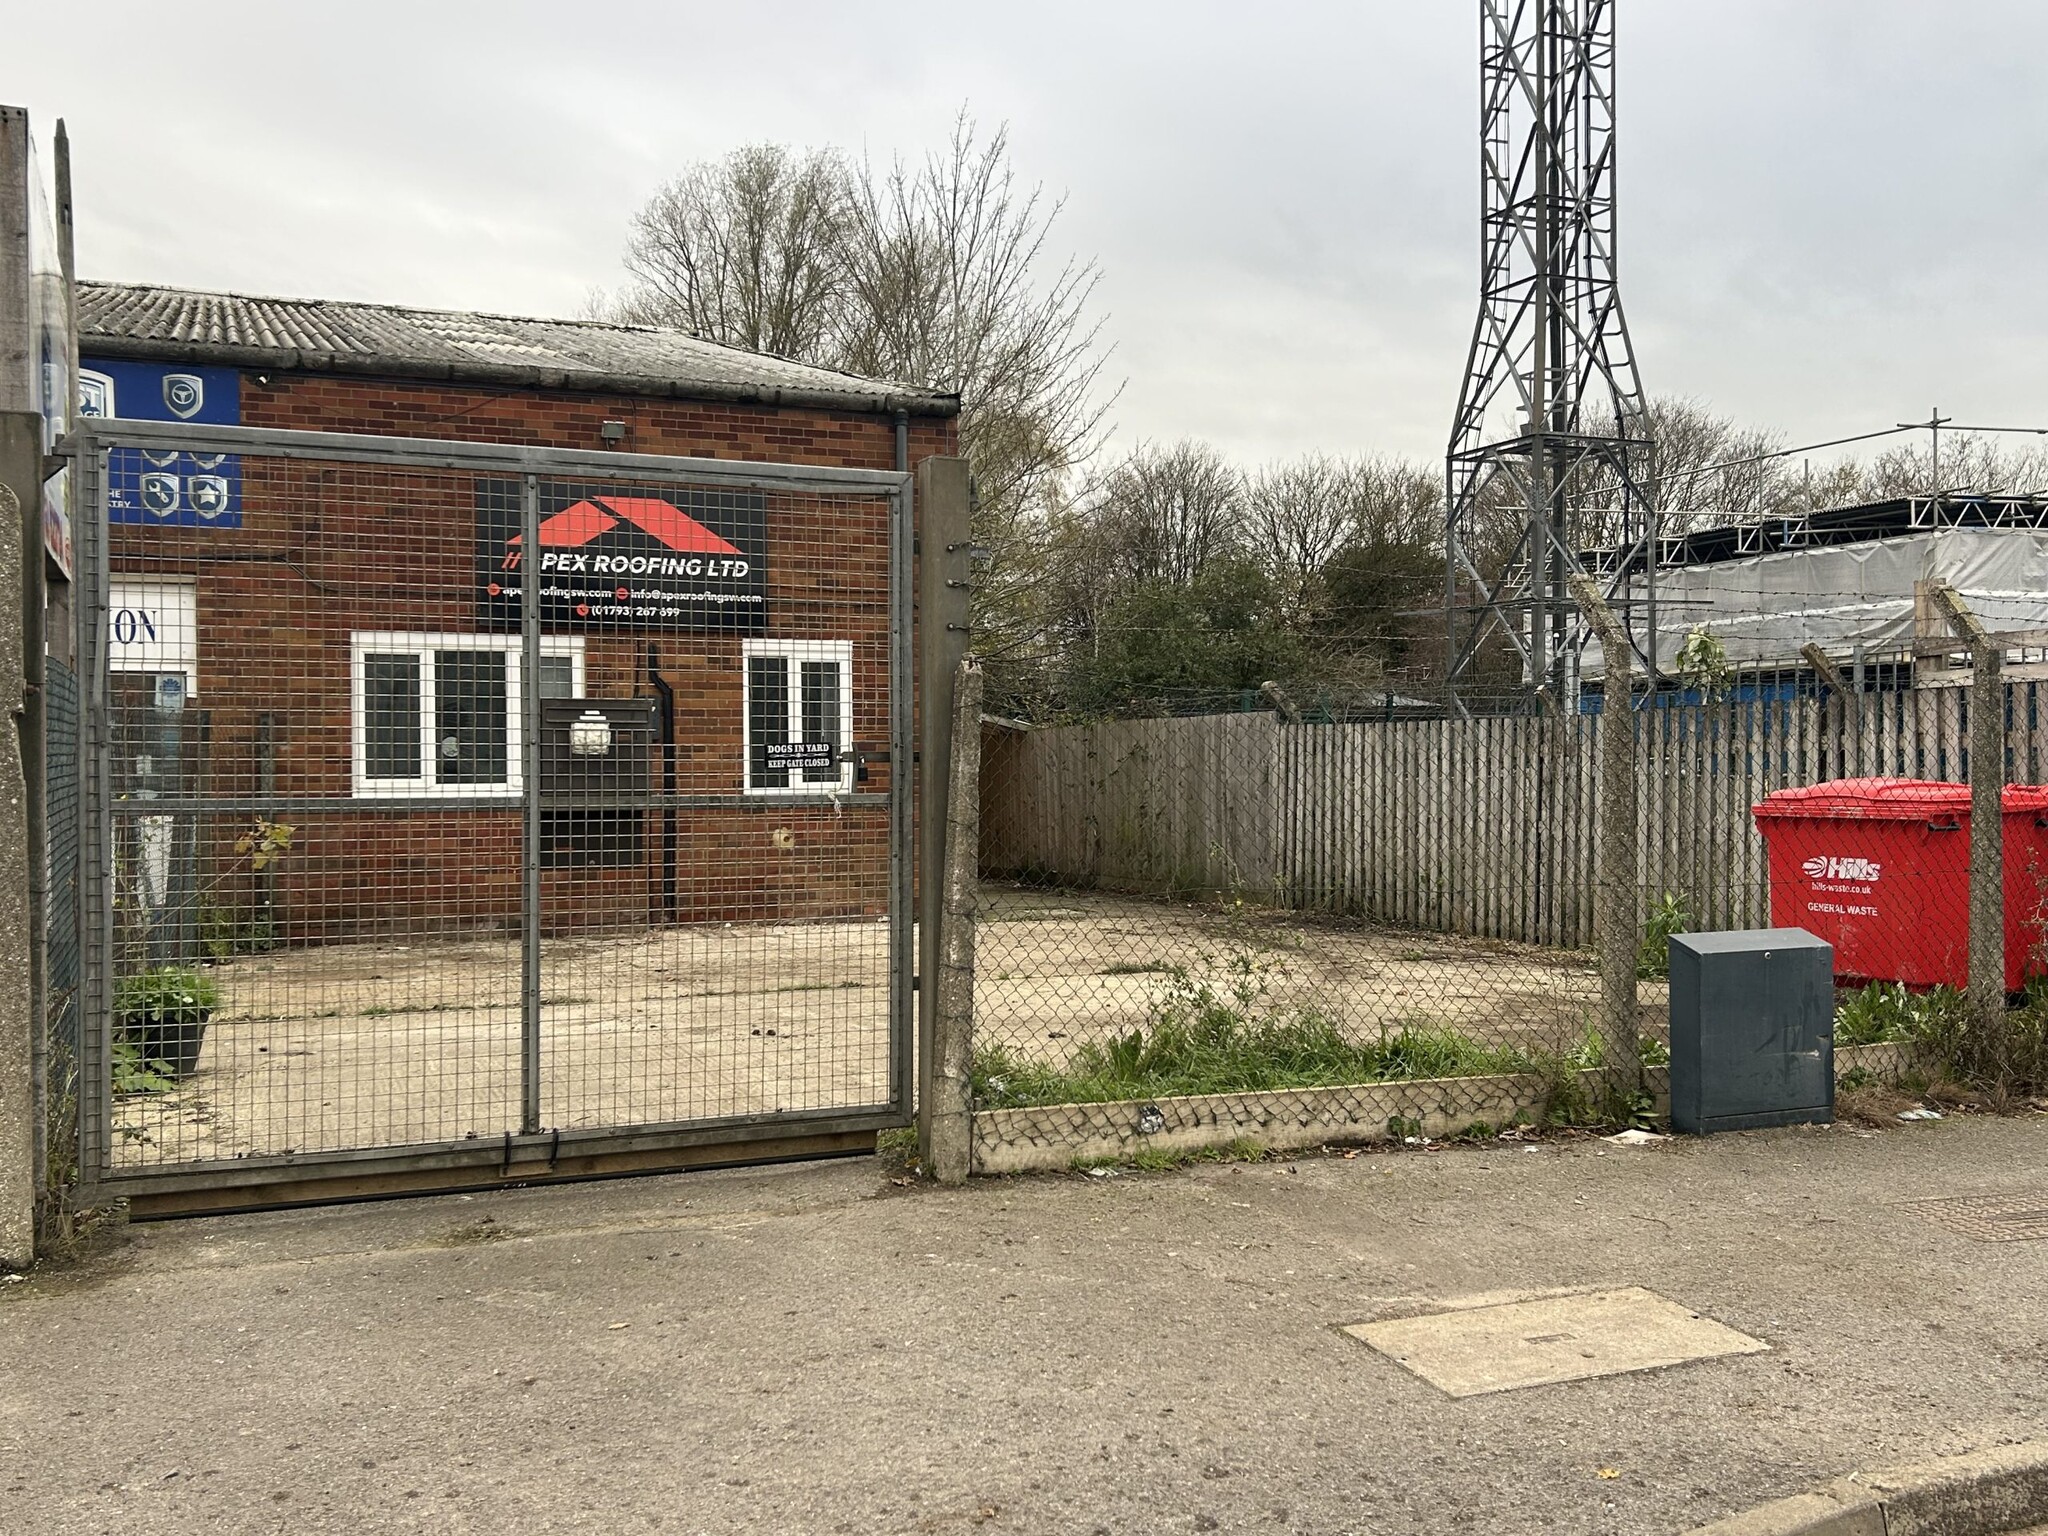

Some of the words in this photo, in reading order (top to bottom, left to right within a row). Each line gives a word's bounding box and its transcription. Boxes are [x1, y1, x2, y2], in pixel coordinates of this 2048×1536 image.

[594, 554, 702, 576] ROOFING
[707, 559, 749, 578] LTD
[630, 588, 762, 604] info@apexroofingsw.com
[636, 606, 657, 617] 267
[111, 609, 157, 645] ON
[767, 744, 793, 754] DOGS
[794, 744, 805, 753] IN
[806, 744, 829, 752] YARD
[767, 759, 786, 768] KEEP
[786, 759, 804, 767] GATE
[804, 758, 830, 767] CLOSED
[1827, 857, 1881, 881] Hills
[1807, 902, 1846, 914] GENERAL
[1847, 905, 1878, 916] WASTE
